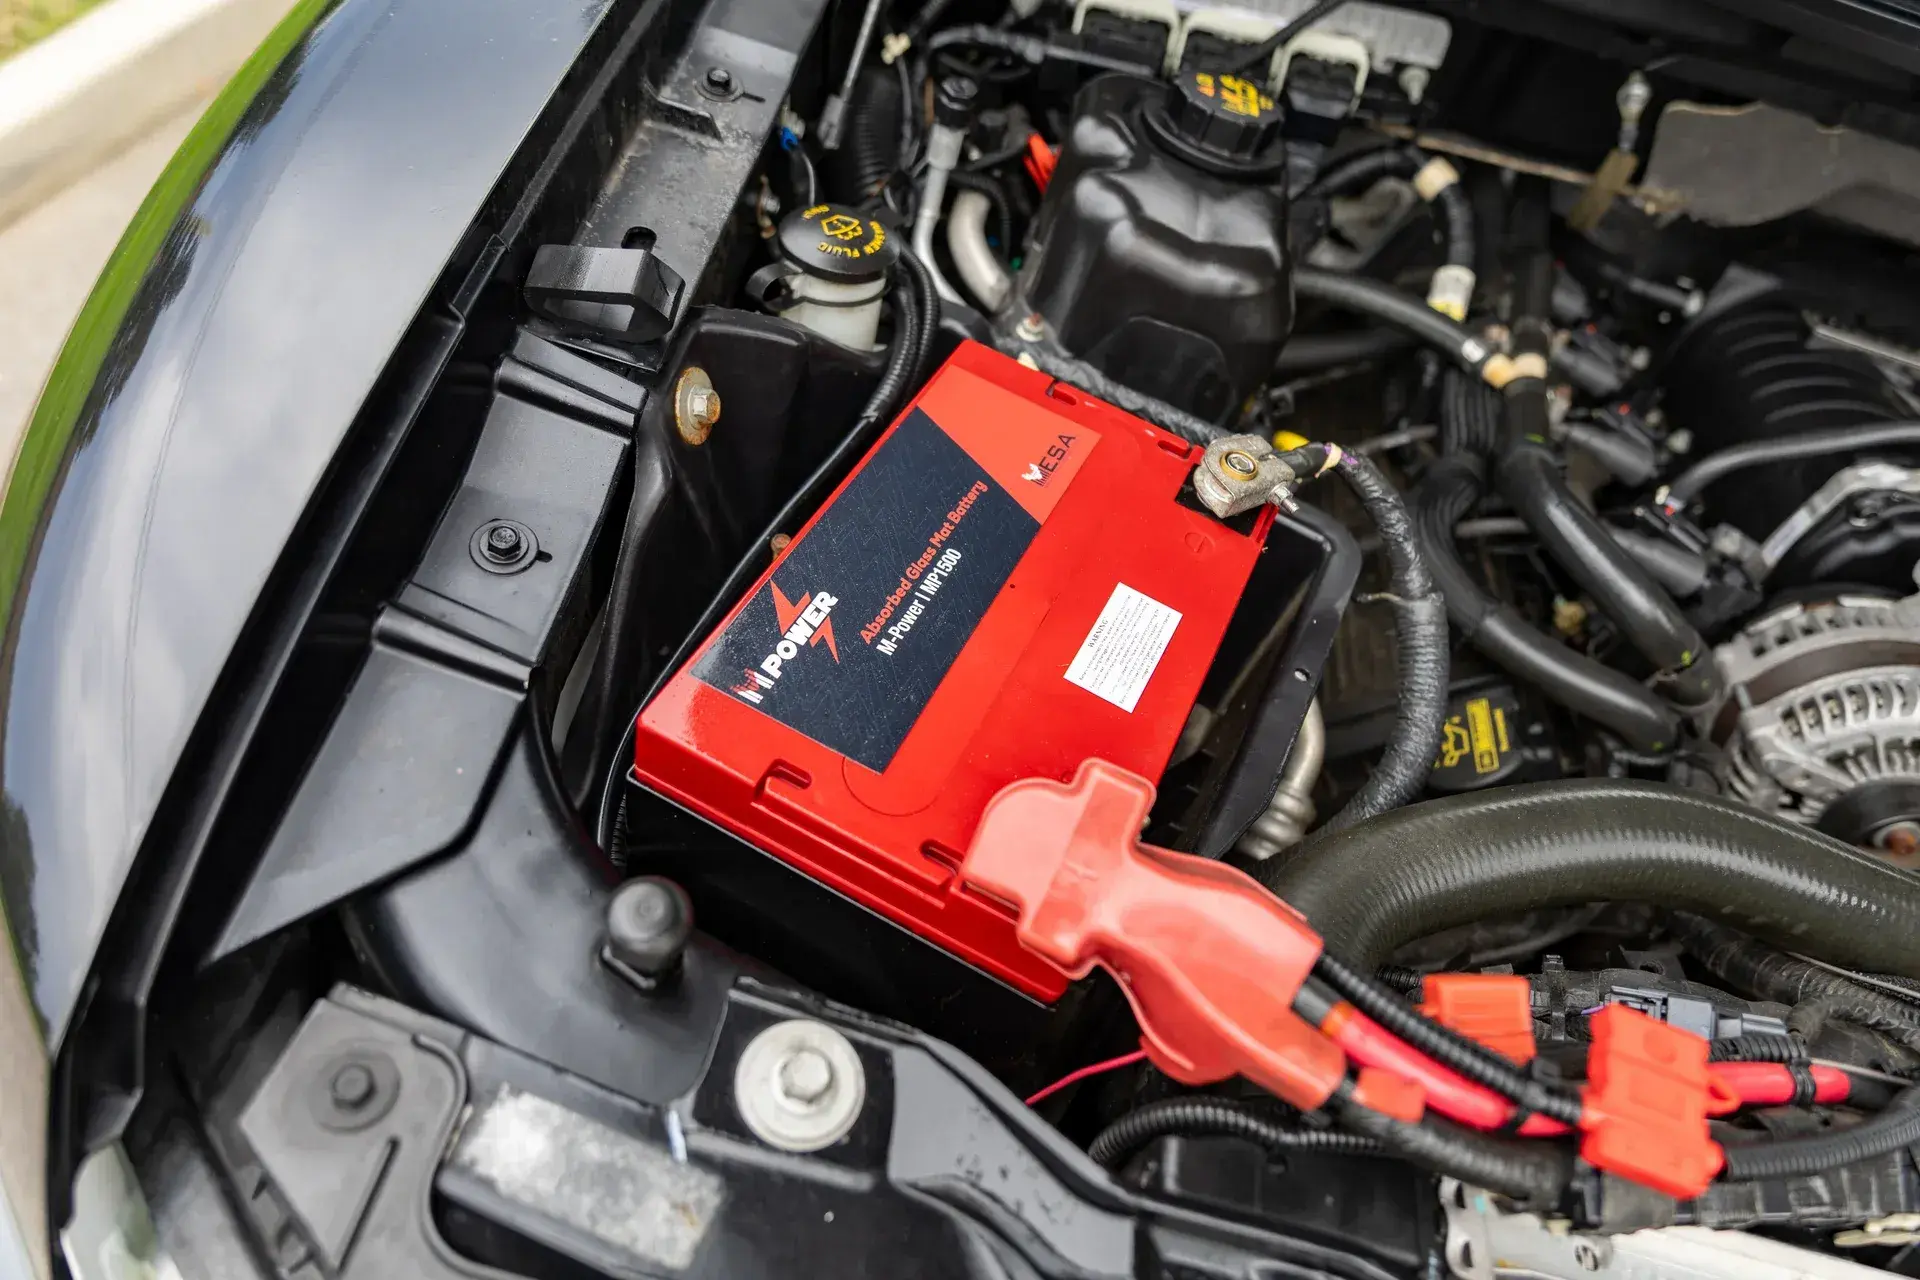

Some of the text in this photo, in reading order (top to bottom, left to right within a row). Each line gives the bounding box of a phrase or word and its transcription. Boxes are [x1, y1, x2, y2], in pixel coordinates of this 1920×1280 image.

[818, 241, 860, 258] FLUID
[1021, 434, 1076, 486] MESA
[859, 480, 989, 645] Absorbed Glass Mat Battery
[876, 599, 926, 656] M-Power
[920, 548, 962, 596] MP1500
